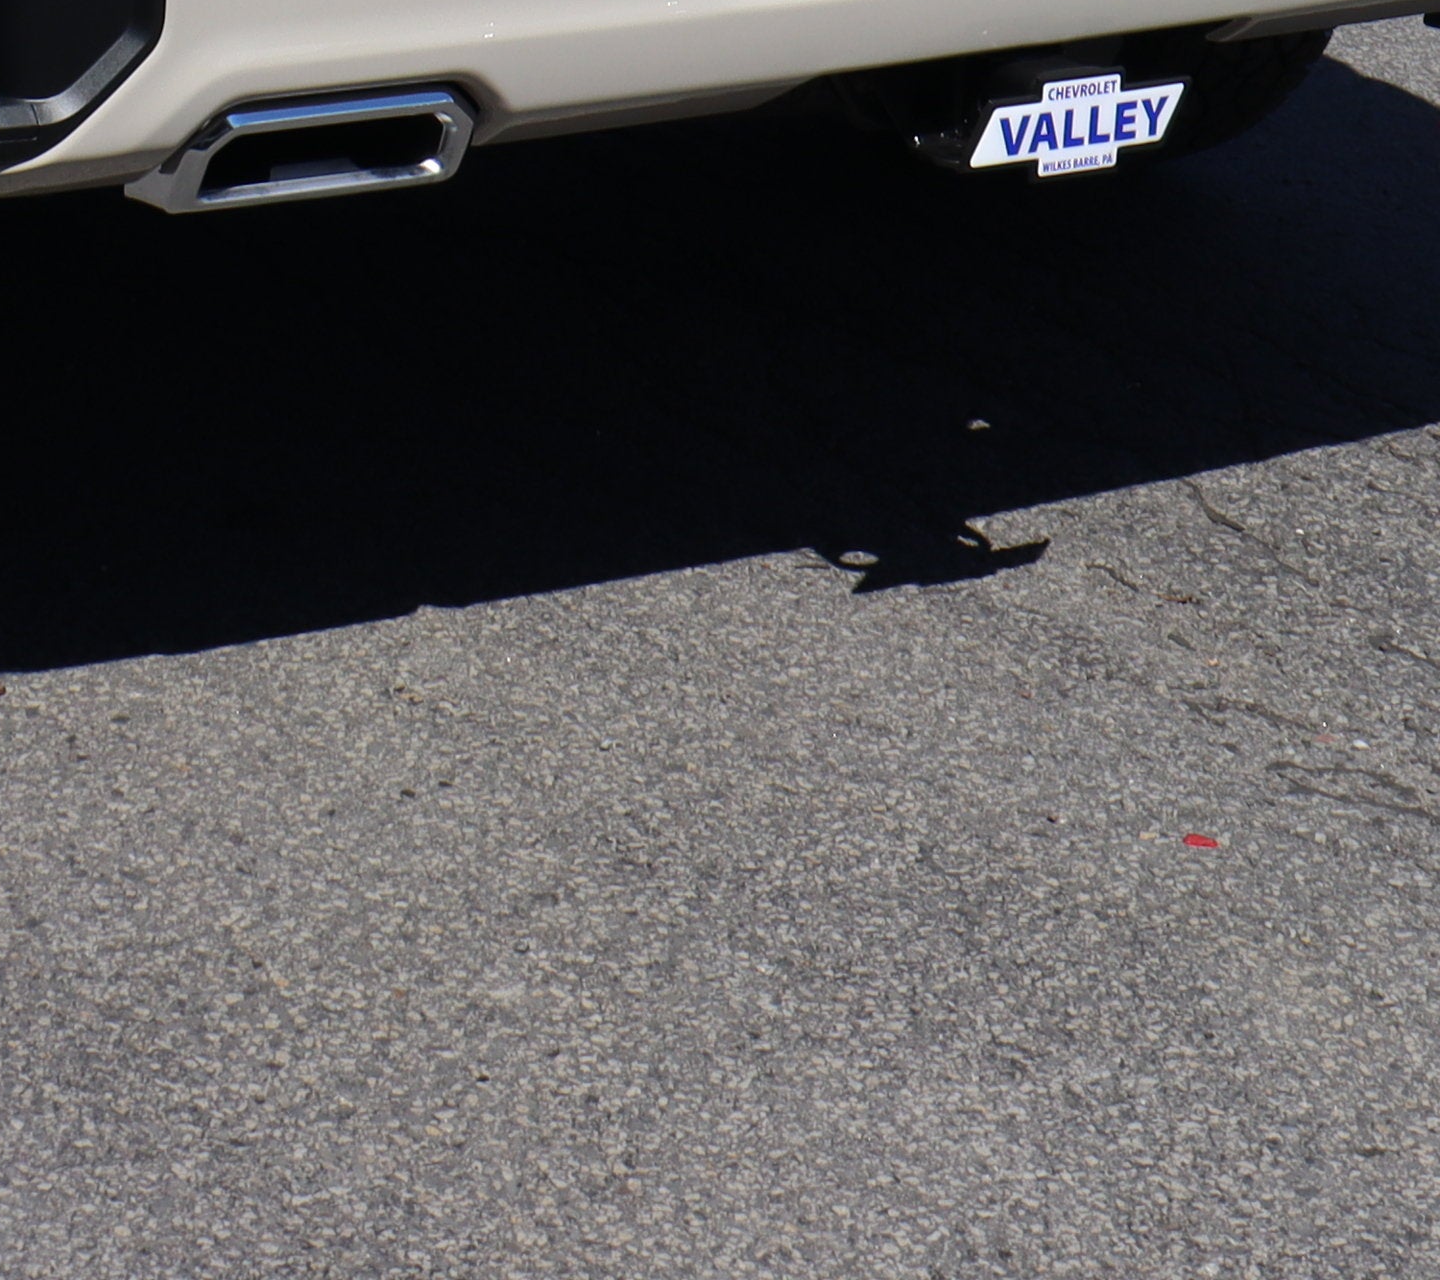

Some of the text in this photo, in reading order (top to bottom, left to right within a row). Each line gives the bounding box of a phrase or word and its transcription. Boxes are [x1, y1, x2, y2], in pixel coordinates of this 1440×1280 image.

[1048, 79, 1118, 102] CHEVROLET
[999, 95, 1171, 157] VALLEY
[1042, 151, 1114, 173] WILKES BARRE, PA
